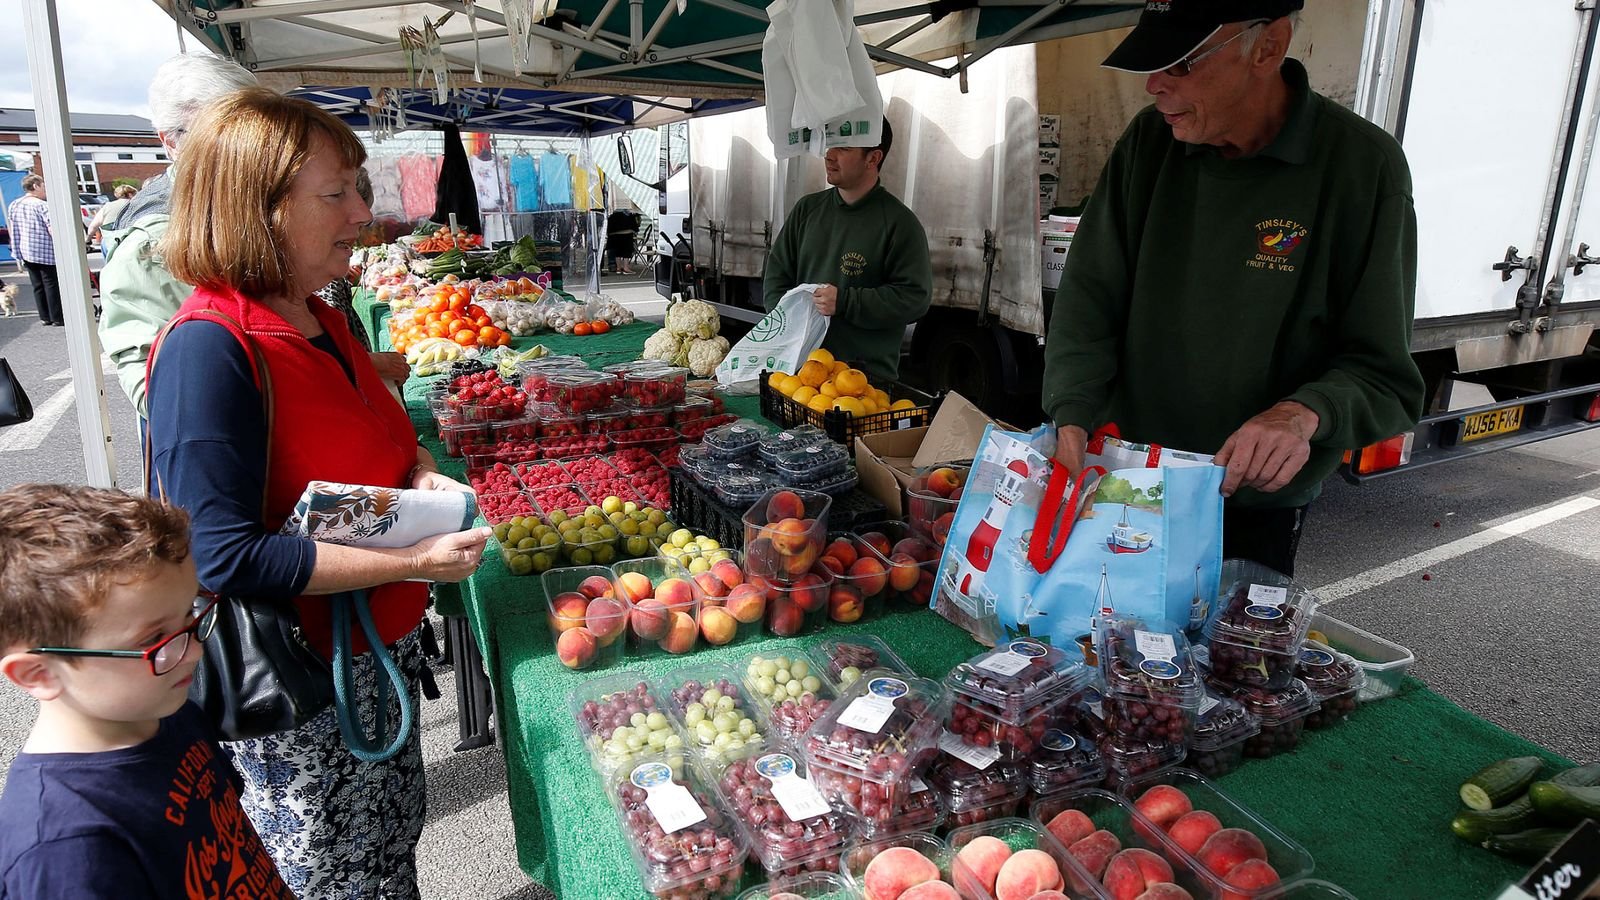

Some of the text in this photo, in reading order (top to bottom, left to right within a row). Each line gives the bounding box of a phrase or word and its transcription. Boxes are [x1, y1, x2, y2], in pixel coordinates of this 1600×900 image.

[1255, 218, 1308, 237] TINSLEY'S
[1255, 253, 1288, 264] QUALITY
[1046, 262, 1065, 271] CLASS
[1245, 260, 1295, 272] FRUIT & VEG
[1463, 408, 1521, 437] AU56 FKA
